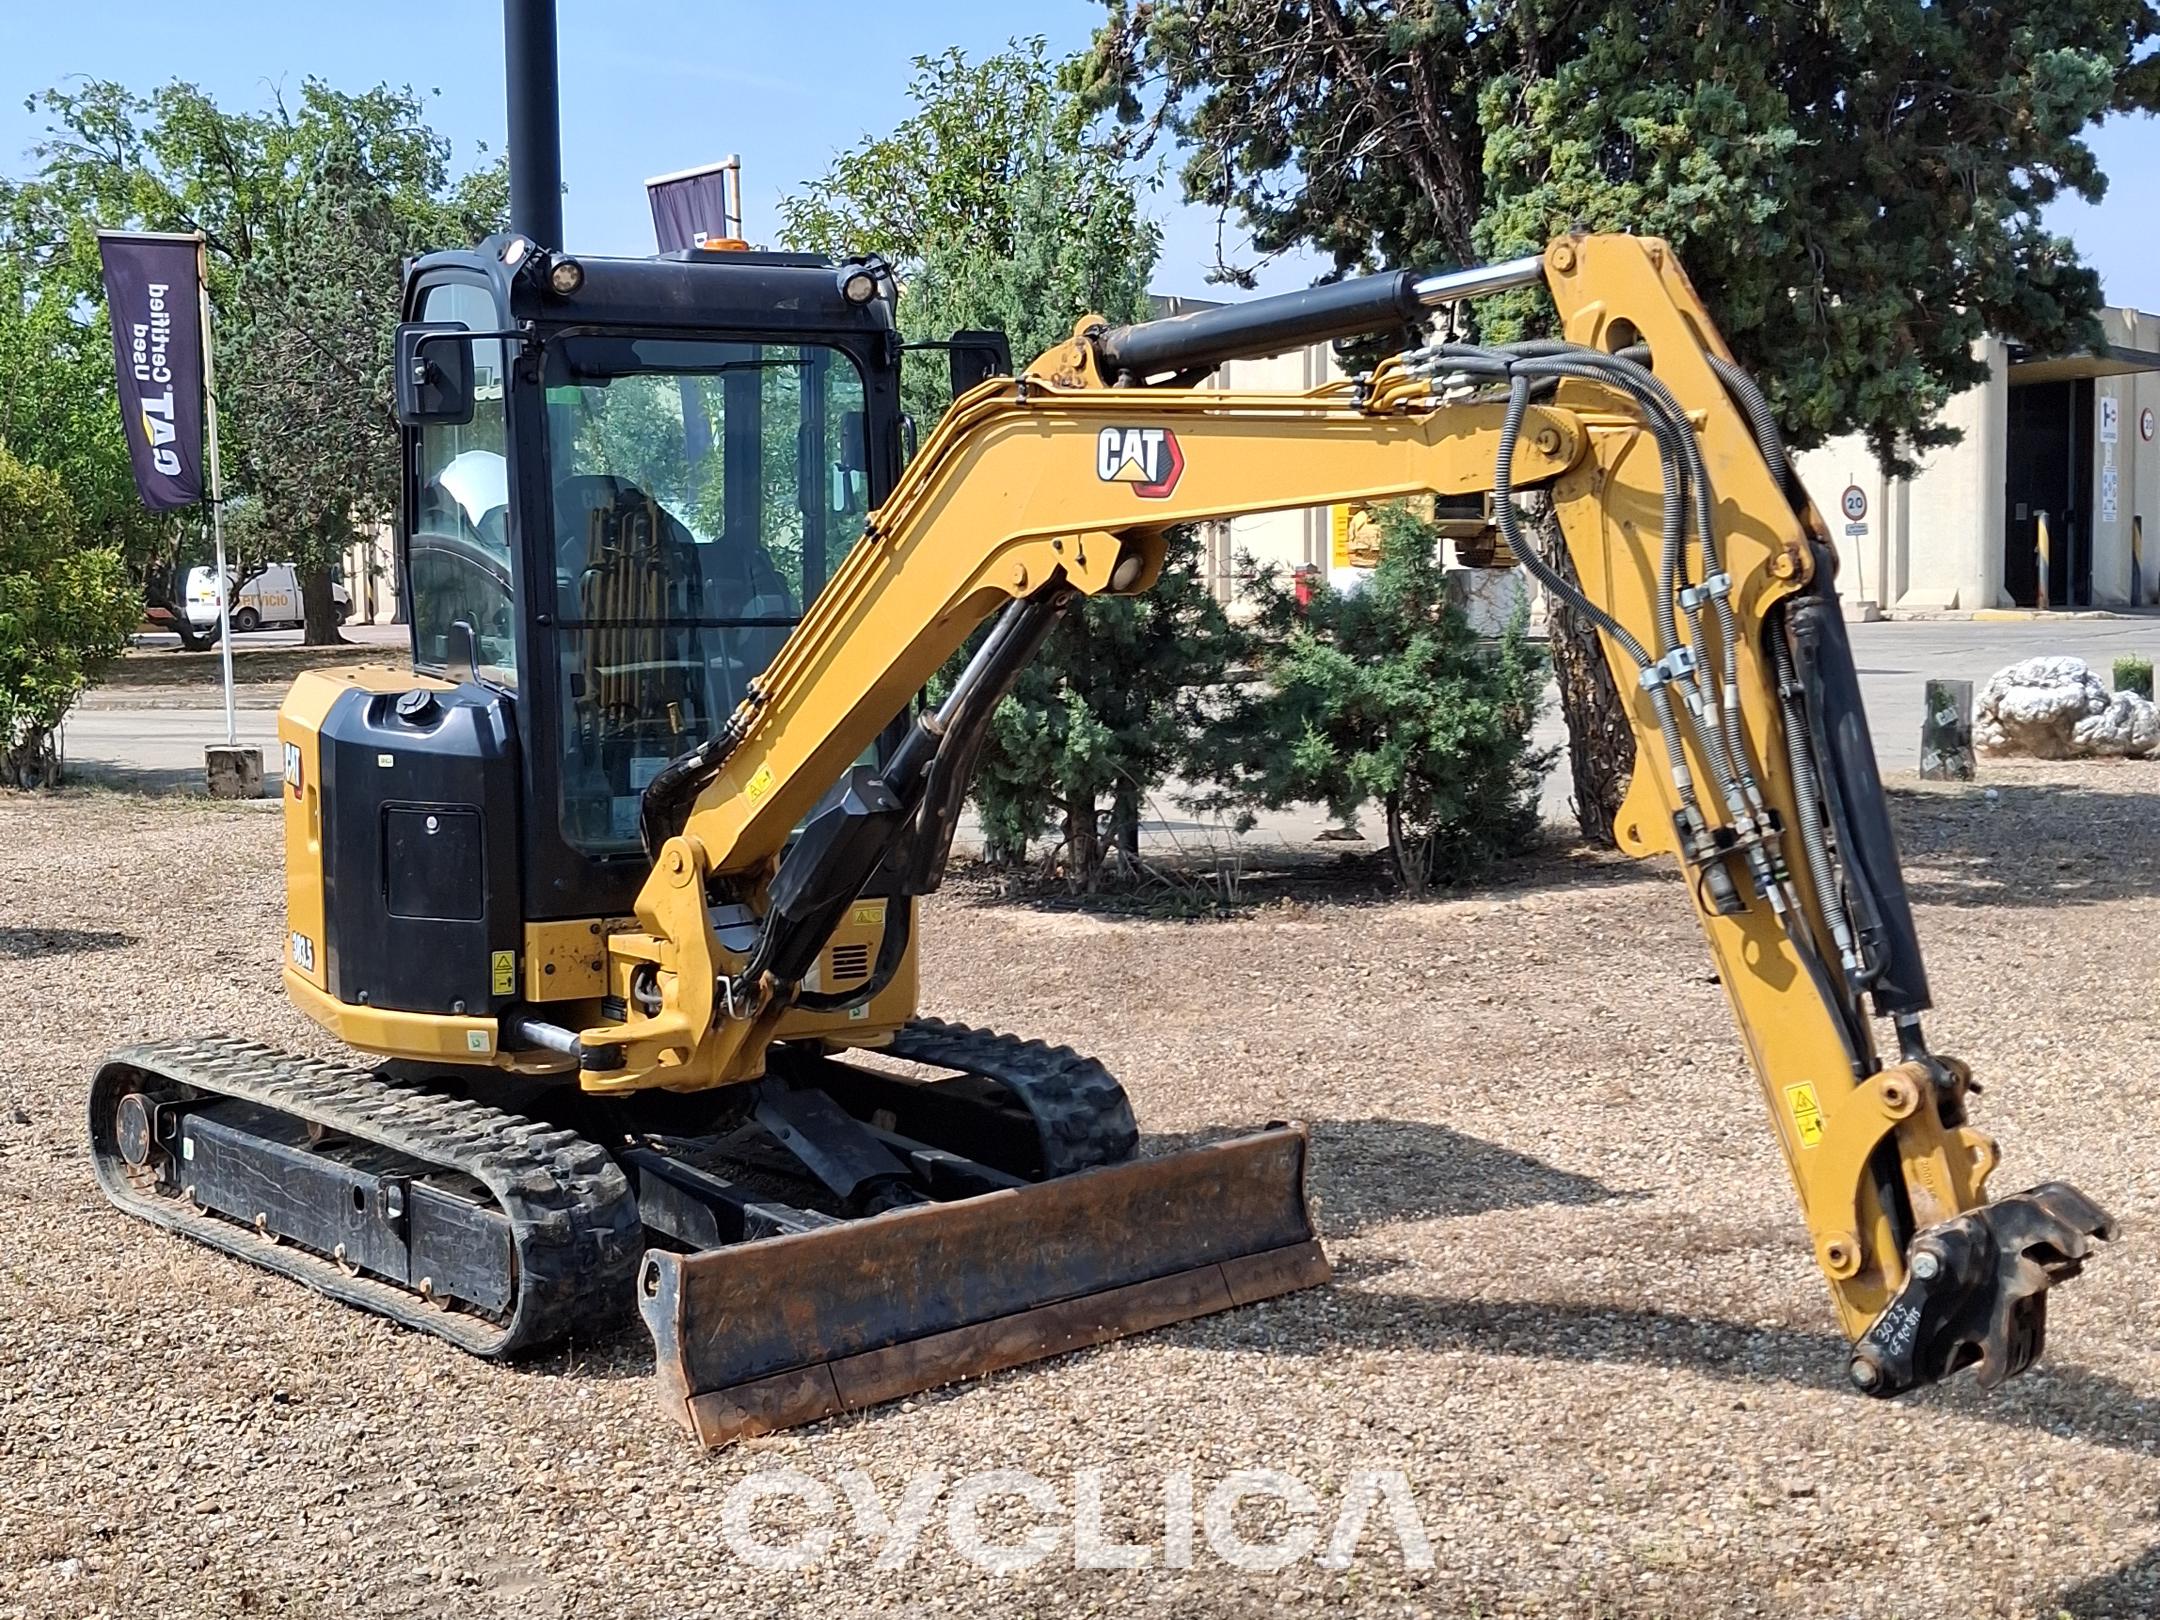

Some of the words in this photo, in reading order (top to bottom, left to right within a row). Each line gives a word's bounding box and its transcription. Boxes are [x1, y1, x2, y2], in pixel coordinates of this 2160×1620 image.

[1098, 427, 1164, 482] CAT
[1847, 497, 1863, 509] 20
[285, 742, 301, 787] CAT
